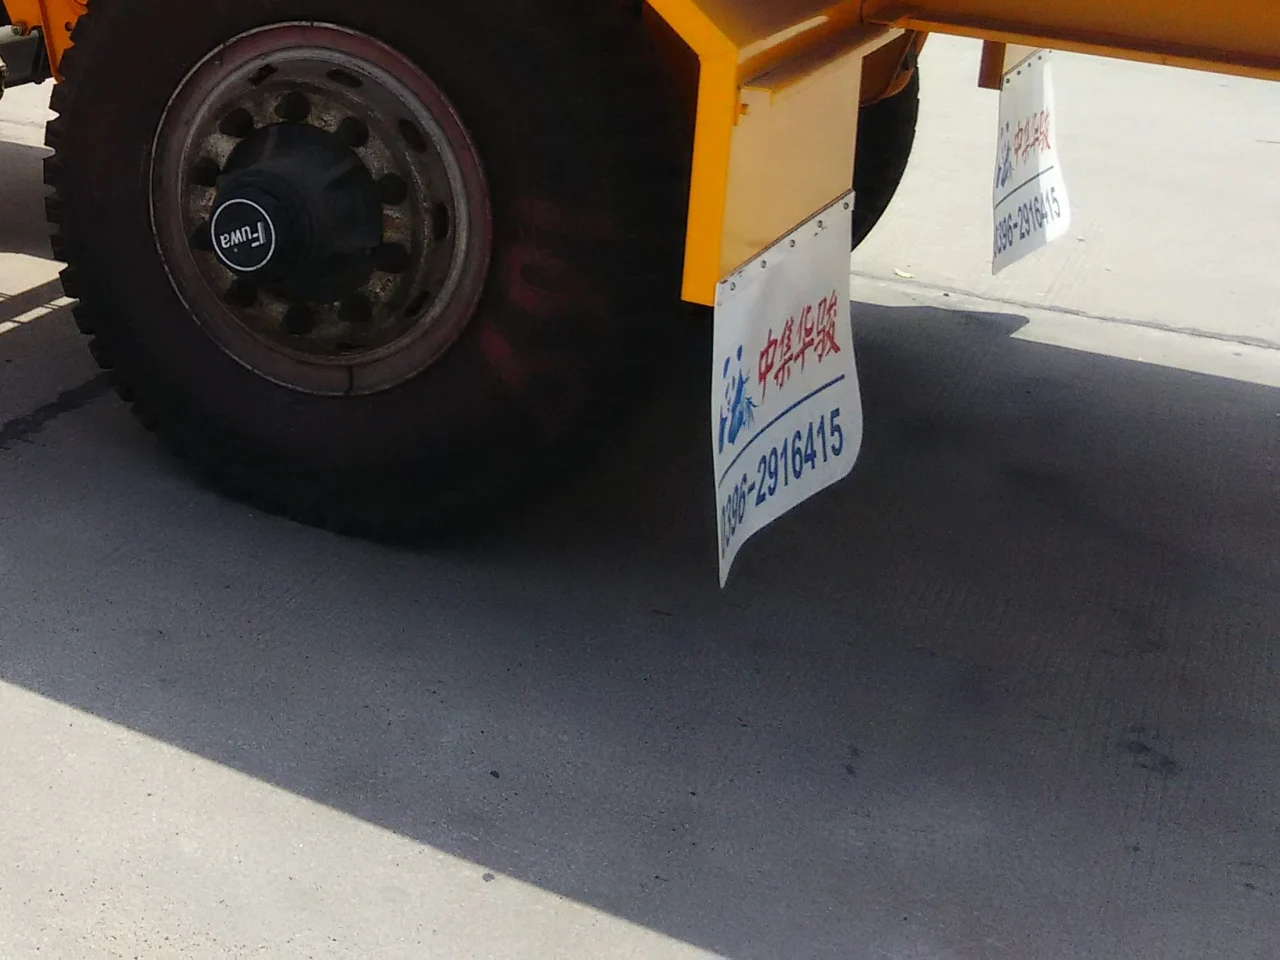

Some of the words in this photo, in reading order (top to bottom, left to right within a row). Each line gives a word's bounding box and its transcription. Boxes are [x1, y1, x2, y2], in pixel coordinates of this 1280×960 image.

[220, 221, 266, 249] Fuwa
[757, 290, 842, 404] 中集华骏
